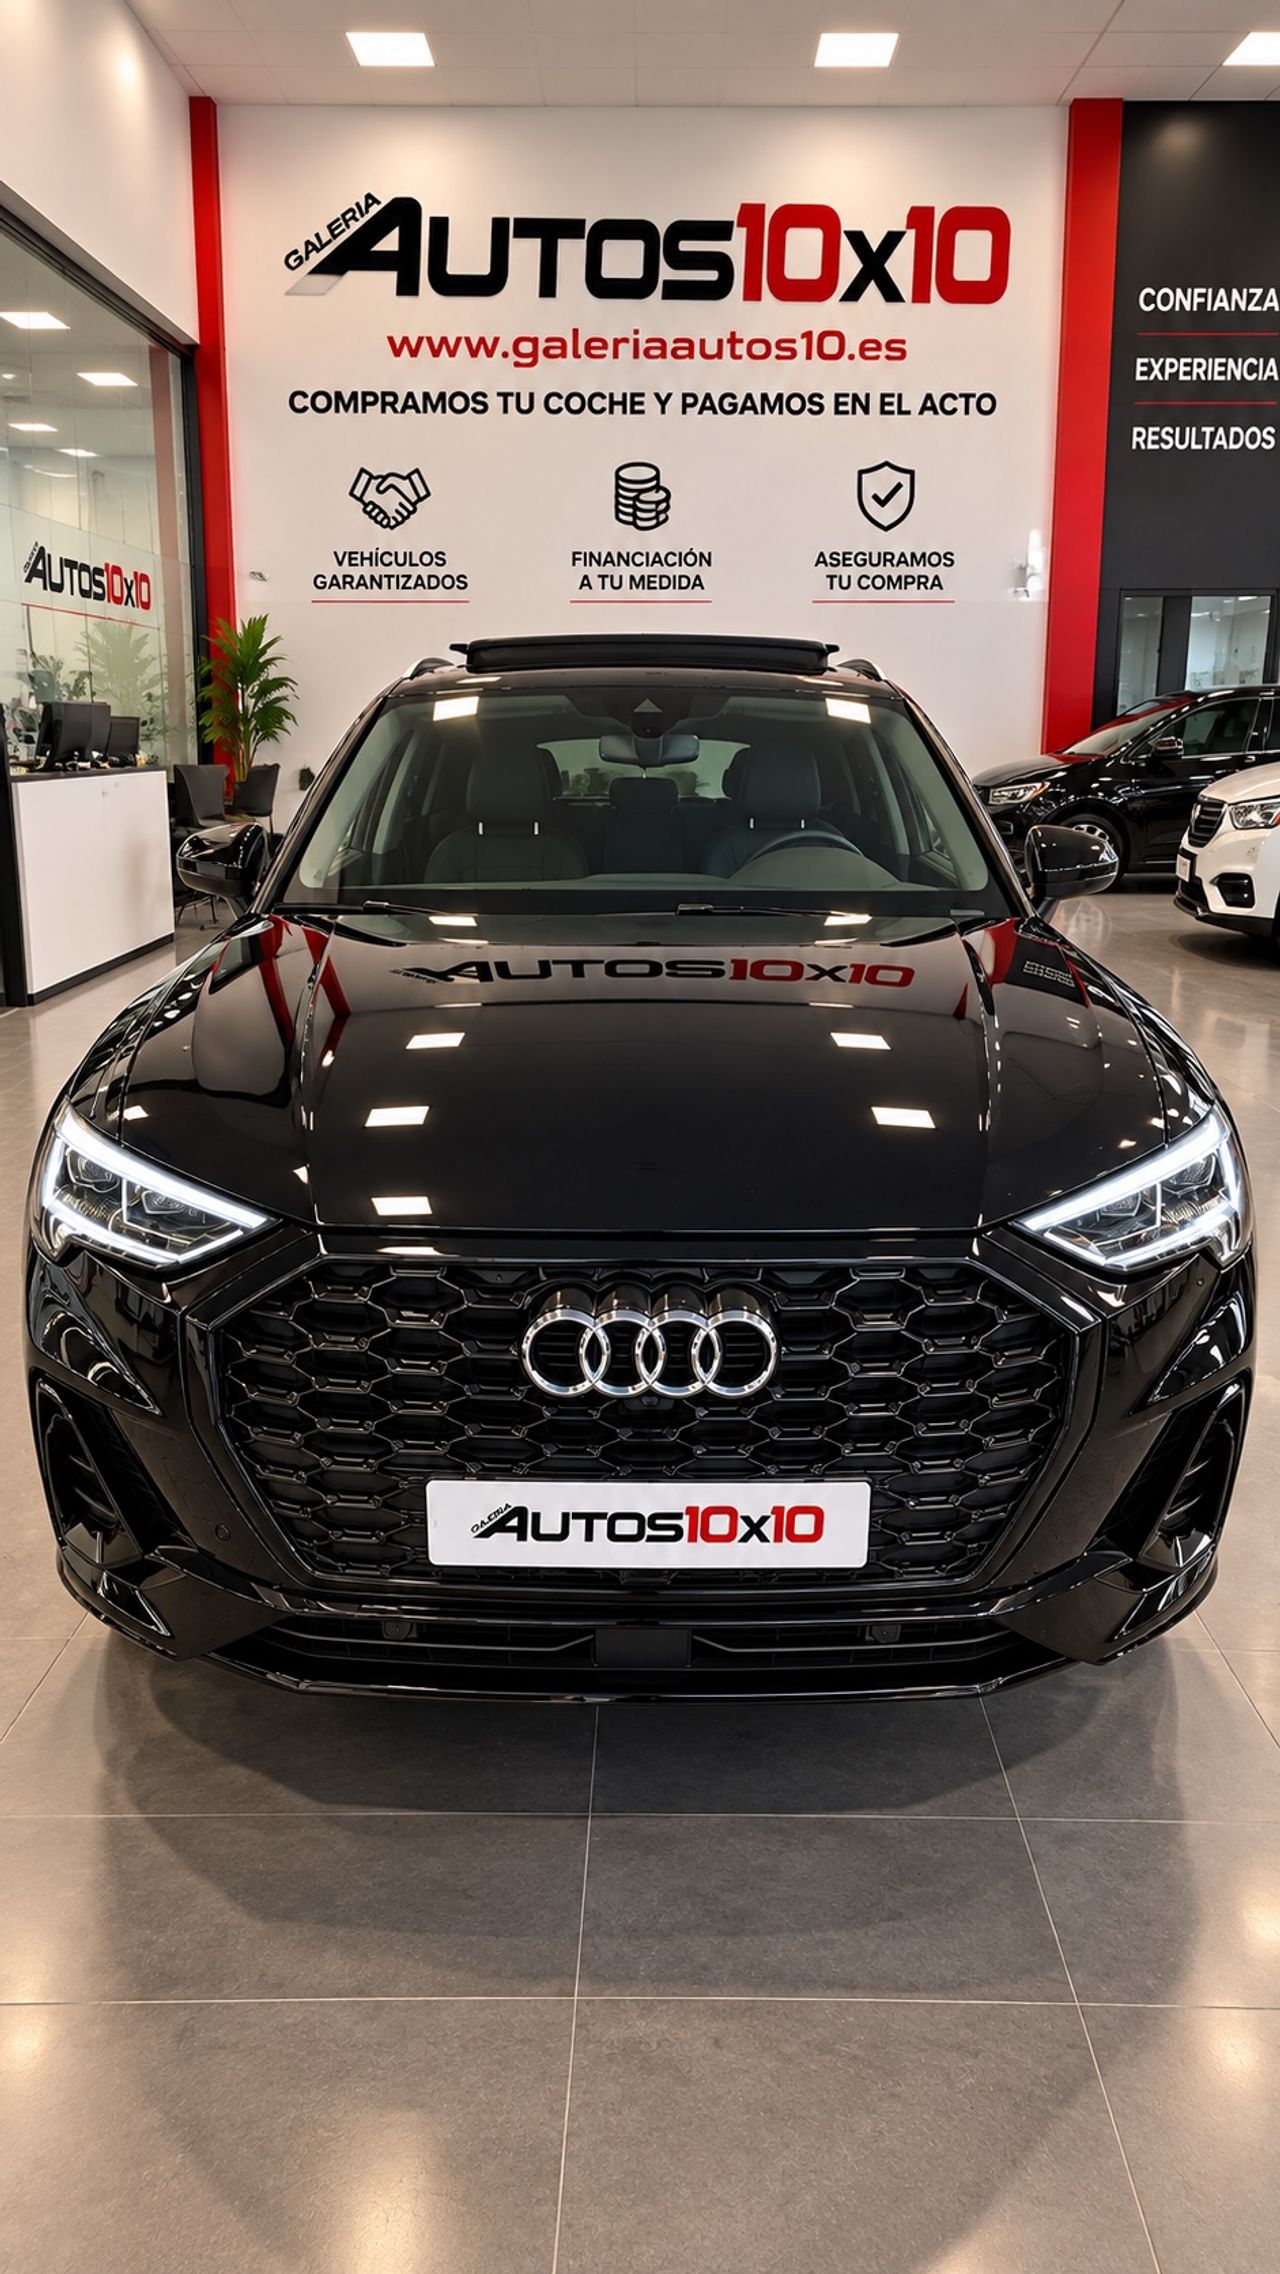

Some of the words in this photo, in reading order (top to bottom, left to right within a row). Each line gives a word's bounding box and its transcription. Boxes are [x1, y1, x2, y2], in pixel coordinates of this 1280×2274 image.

[284, 192, 381, 271] GALERIA
[285, 196, 1011, 304] AUTOS10x10
[1138, 287, 1280, 312] CONFIANZA
[387, 328, 907, 368] www.galeriaautos10.es
[1135, 357, 1279, 381] EXPERIENCIA
[288, 390, 490, 415] COMPRAMOS
[500, 391, 535, 415] TU
[543, 391, 646, 415] COCHE
[657, 391, 673, 415] Y
[681, 391, 825, 416] PAGAMOS
[833, 392, 871, 416] EN
[879, 392, 912, 416] EL
[918, 392, 997, 416] ACTO
[1131, 426, 1276, 450] RESULTADOS
[333, 546, 447, 568] VEHÍCULOS
[571, 547, 712, 568] FINANCIACIÓN
[814, 551, 955, 568] ASEGURAMOS
[312, 573, 469, 591] GARANTIZADOS
[578, 574, 593, 591] A
[597, 574, 623, 591] TU
[629, 574, 705, 591] MEDIDA
[825, 574, 852, 591] TU
[856, 574, 944, 591] COMPRA
[473, 1505, 825, 1544] AUTOS10x10
